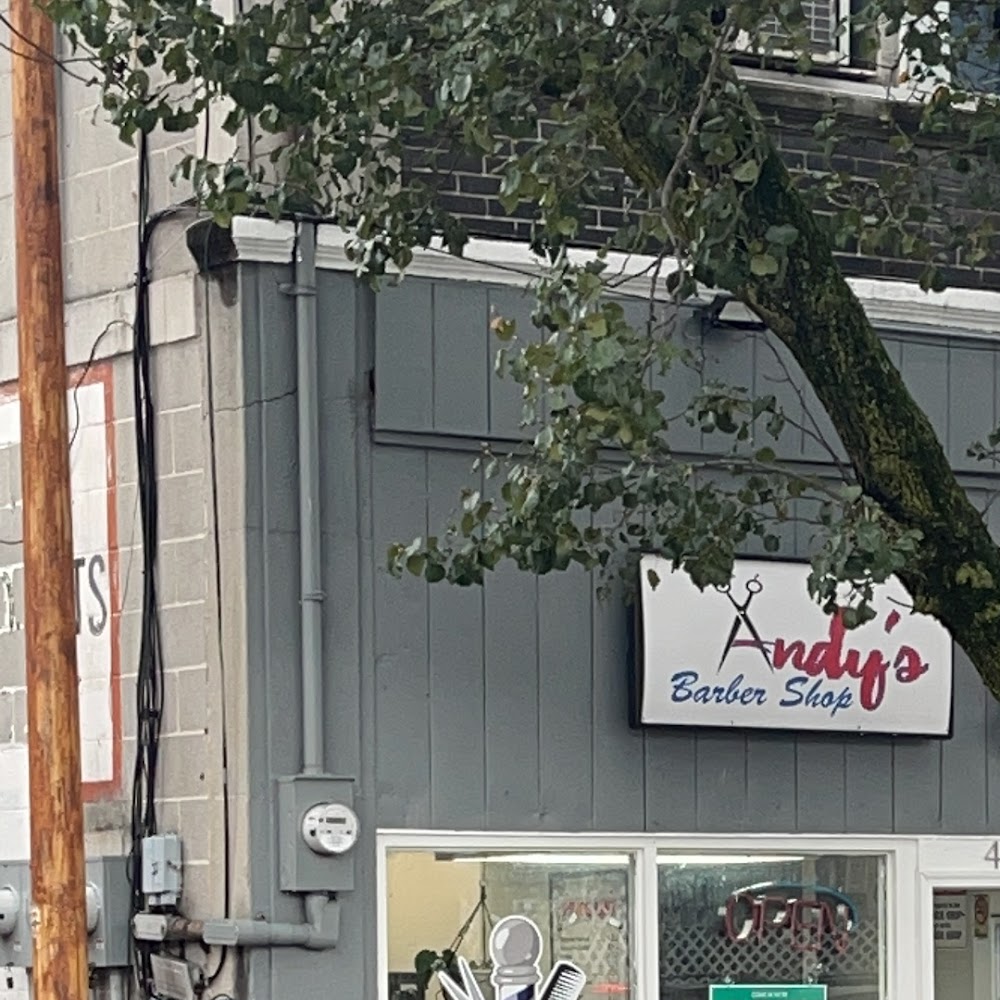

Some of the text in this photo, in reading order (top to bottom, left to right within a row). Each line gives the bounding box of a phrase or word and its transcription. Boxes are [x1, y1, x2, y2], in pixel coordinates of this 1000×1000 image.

[717, 574, 929, 711] Andy's
[671, 671, 853, 716] Barber Shop
